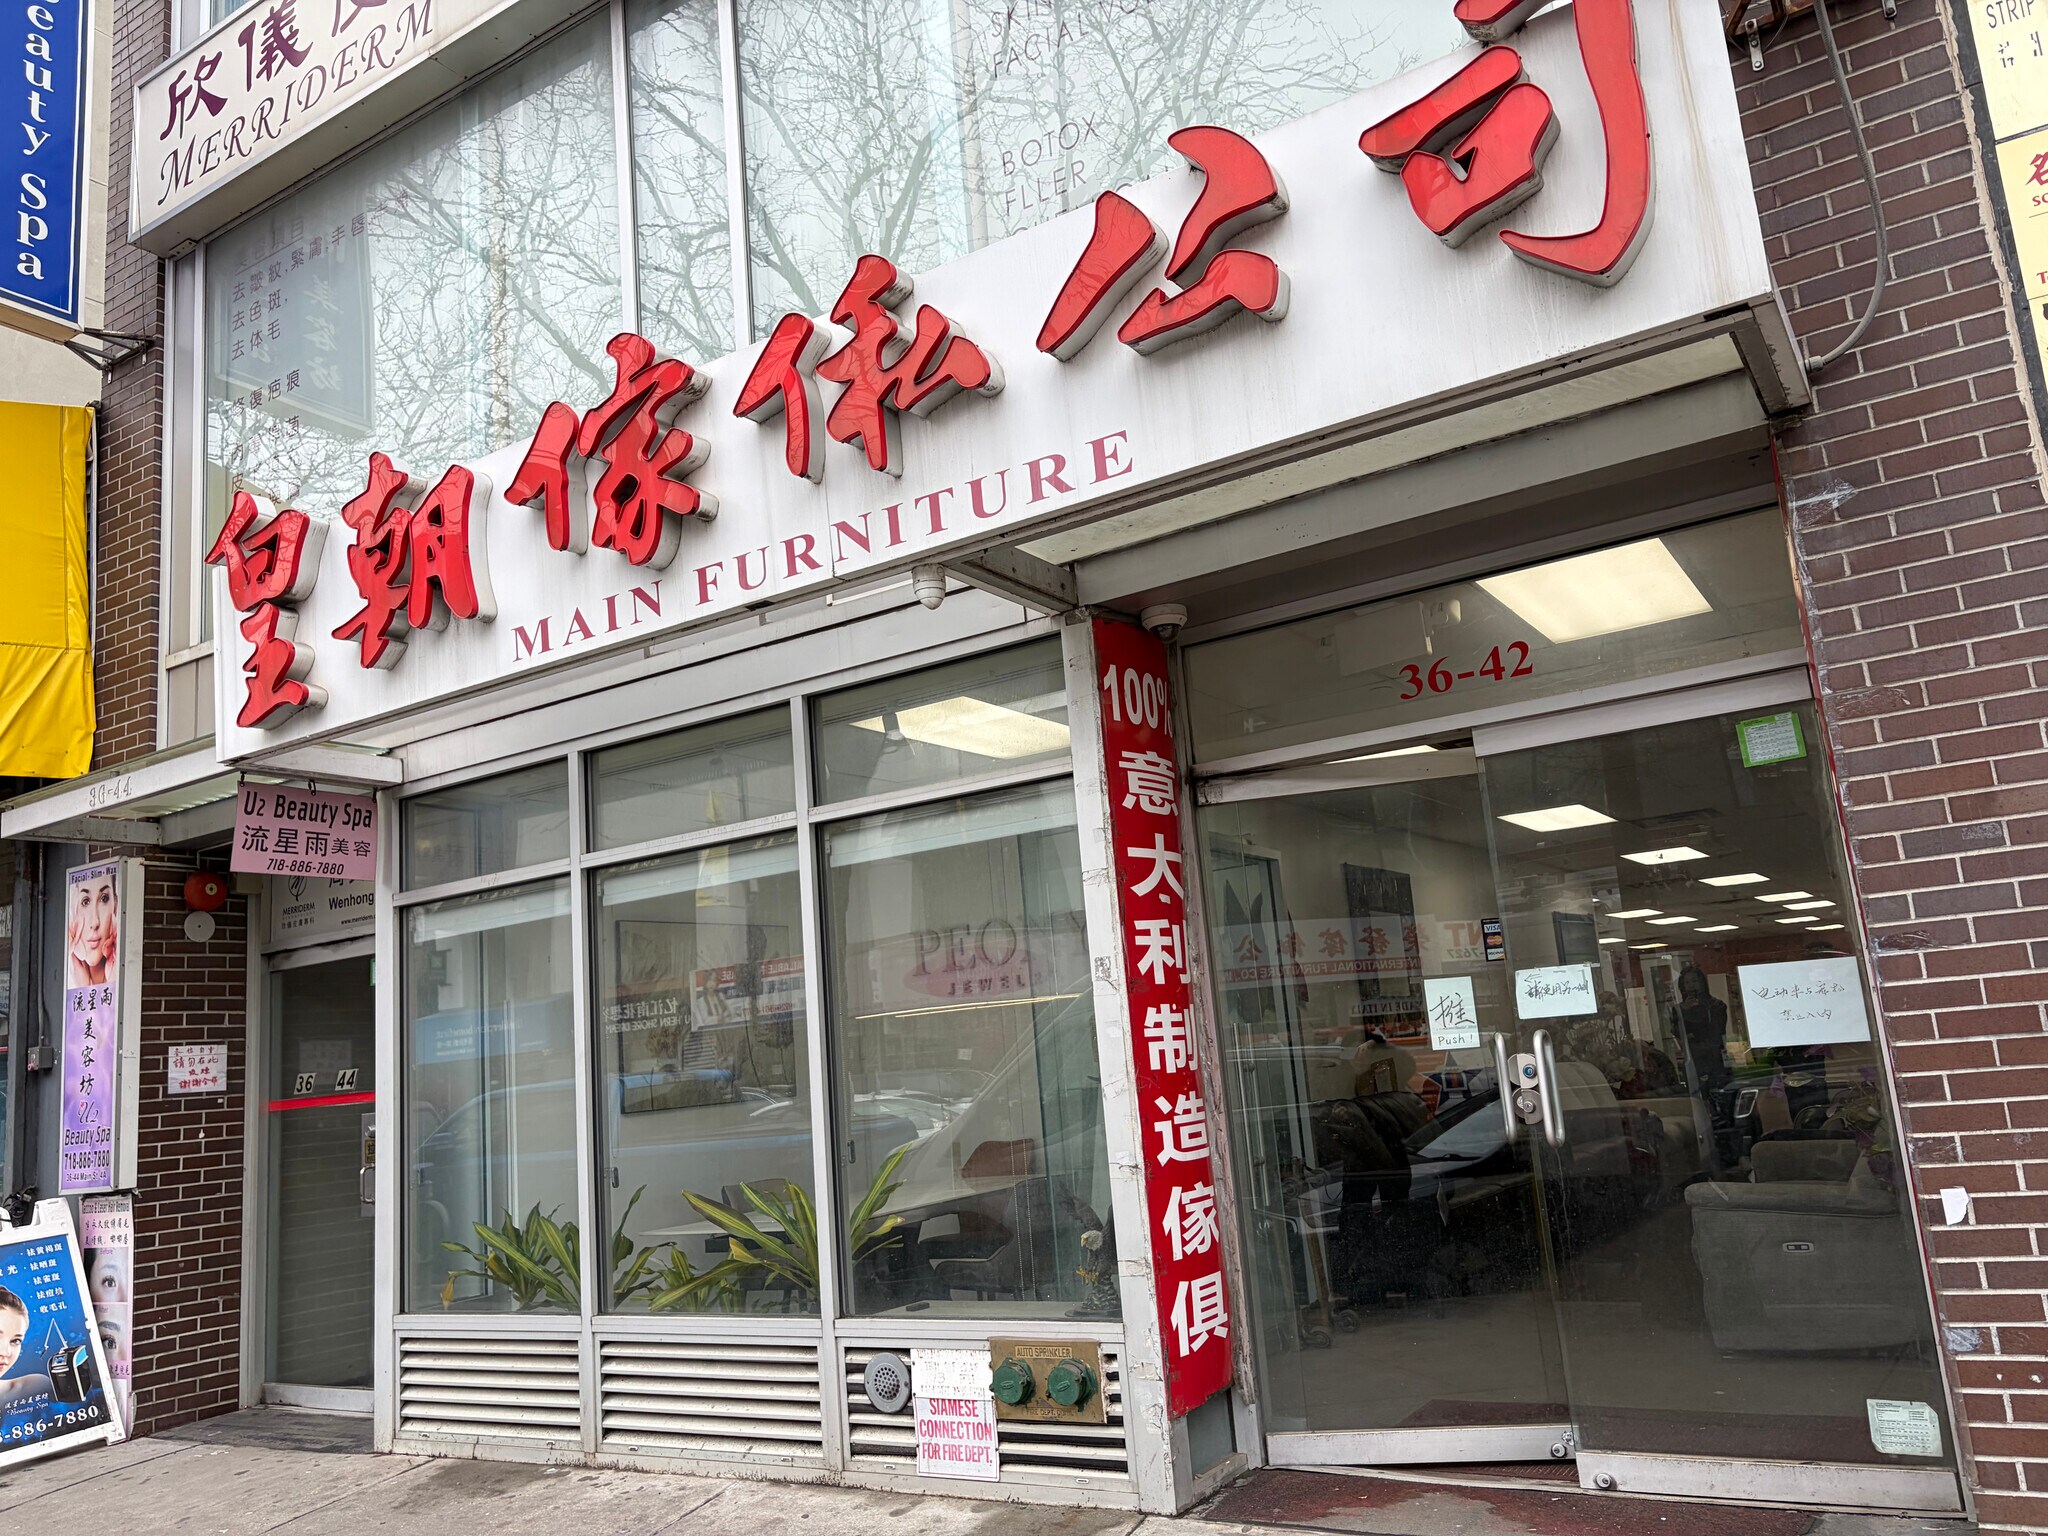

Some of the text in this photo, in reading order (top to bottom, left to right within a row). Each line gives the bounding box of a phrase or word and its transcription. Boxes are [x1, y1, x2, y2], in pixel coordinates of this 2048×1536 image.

[994, 12, 1089, 78] FACIAL
[158, 0, 433, 205] MERRIDERM
[17, 0, 59, 280] eauty Spa
[1002, 112, 1100, 176] BOTOX
[512, 430, 1135, 663] MAIN FURNITURE
[1399, 640, 1534, 700] 36-42
[1103, 664, 1173, 739] 100%
[244, 790, 372, 831] U2 Beauty Spa
[266, 857, 345, 876] 718-886-7880
[282, 902, 315, 916] MERRIDERM
[328, 893, 375, 911] Wenhong
[72, 987, 113, 1012] 流星雨
[1430, 993, 1475, 1028] 推
[80, 1019, 97, 1097] 美容坊
[296, 1071, 356, 1093] 36 44
[64, 1125, 111, 1147] Beauty Spa
[64, 1149, 110, 1170] 718-886-7880
[1016, 1346, 1071, 1358] AUTO SPRINKLER
[929, 1398, 979, 1418] SIAMESE
[919, 1419, 993, 1441] CONNECTION
[922, 1443, 993, 1464] FOR FIRE DEPT.
